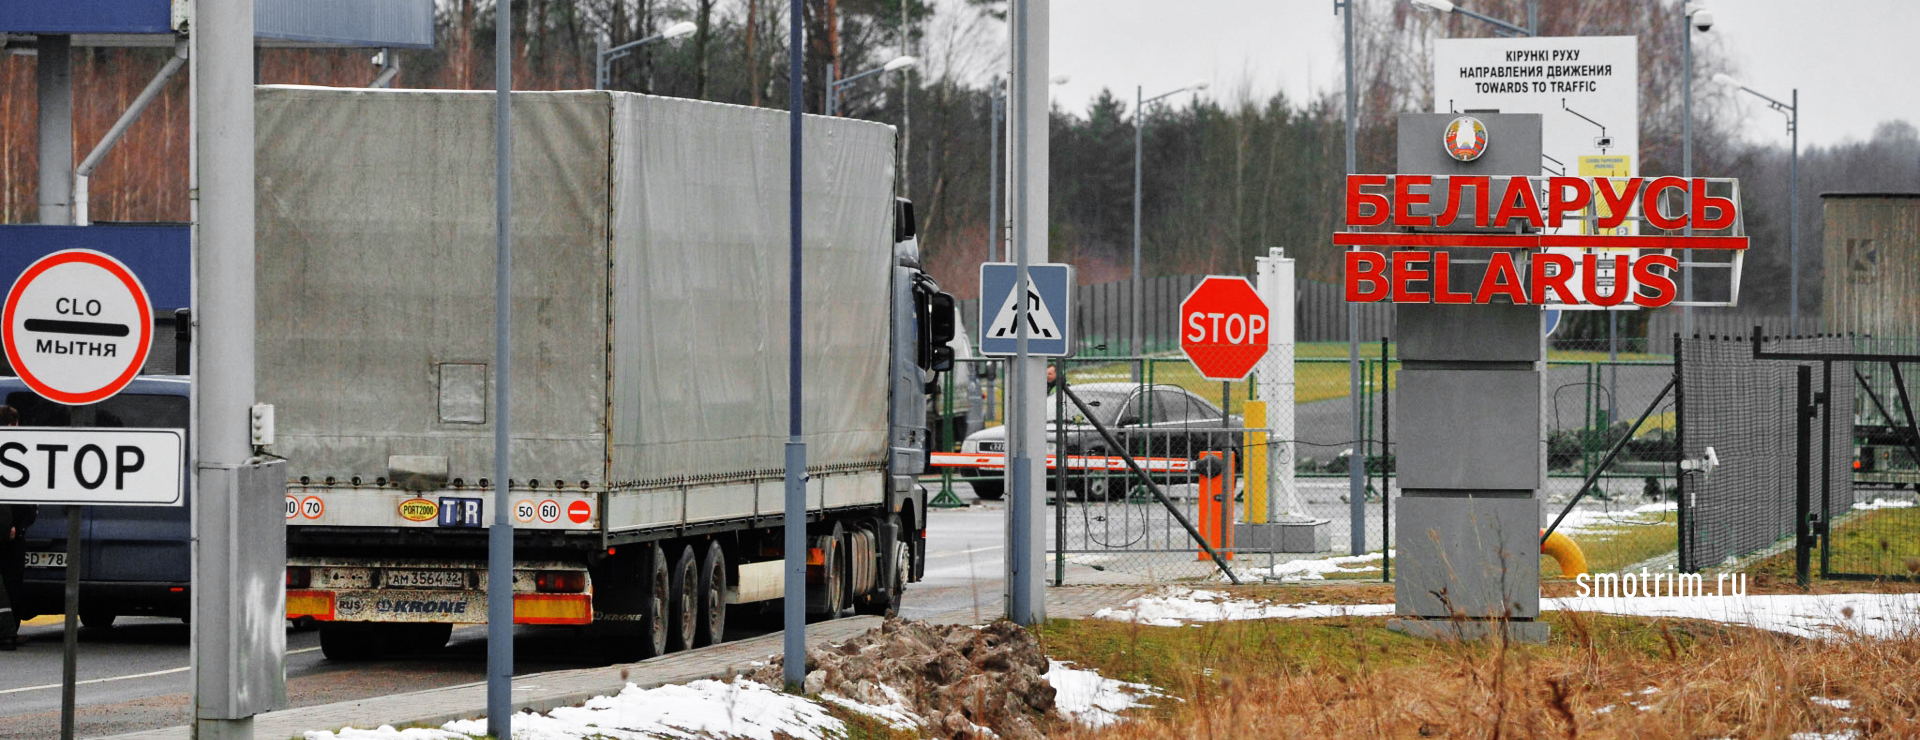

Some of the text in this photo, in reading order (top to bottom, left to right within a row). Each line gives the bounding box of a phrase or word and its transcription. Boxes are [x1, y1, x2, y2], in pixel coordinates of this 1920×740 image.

[1506, 49, 1580, 62] КІРУНКІ РУХУ
[1460, 65, 1612, 79] НАПРАВЛЕНИЯ ДВИЖЕНИЯ
[1475, 81, 1597, 93] TOWARDS TO TRAFFIC
[1346, 174, 1737, 231] БЕЛАРУСЬ
[1345, 251, 1679, 307] BELARUS
[56, 297, 102, 316] CLO
[1187, 311, 1266, 345] STOP
[36, 339, 117, 357] МЫТНЯ
[0, 441, 145, 490] STOP
[306, 502, 320, 513] 70
[518, 506, 533, 517] 50
[542, 505, 556, 518] 60
[339, 600, 361, 610] RUS
[393, 600, 468, 613] KRONE
